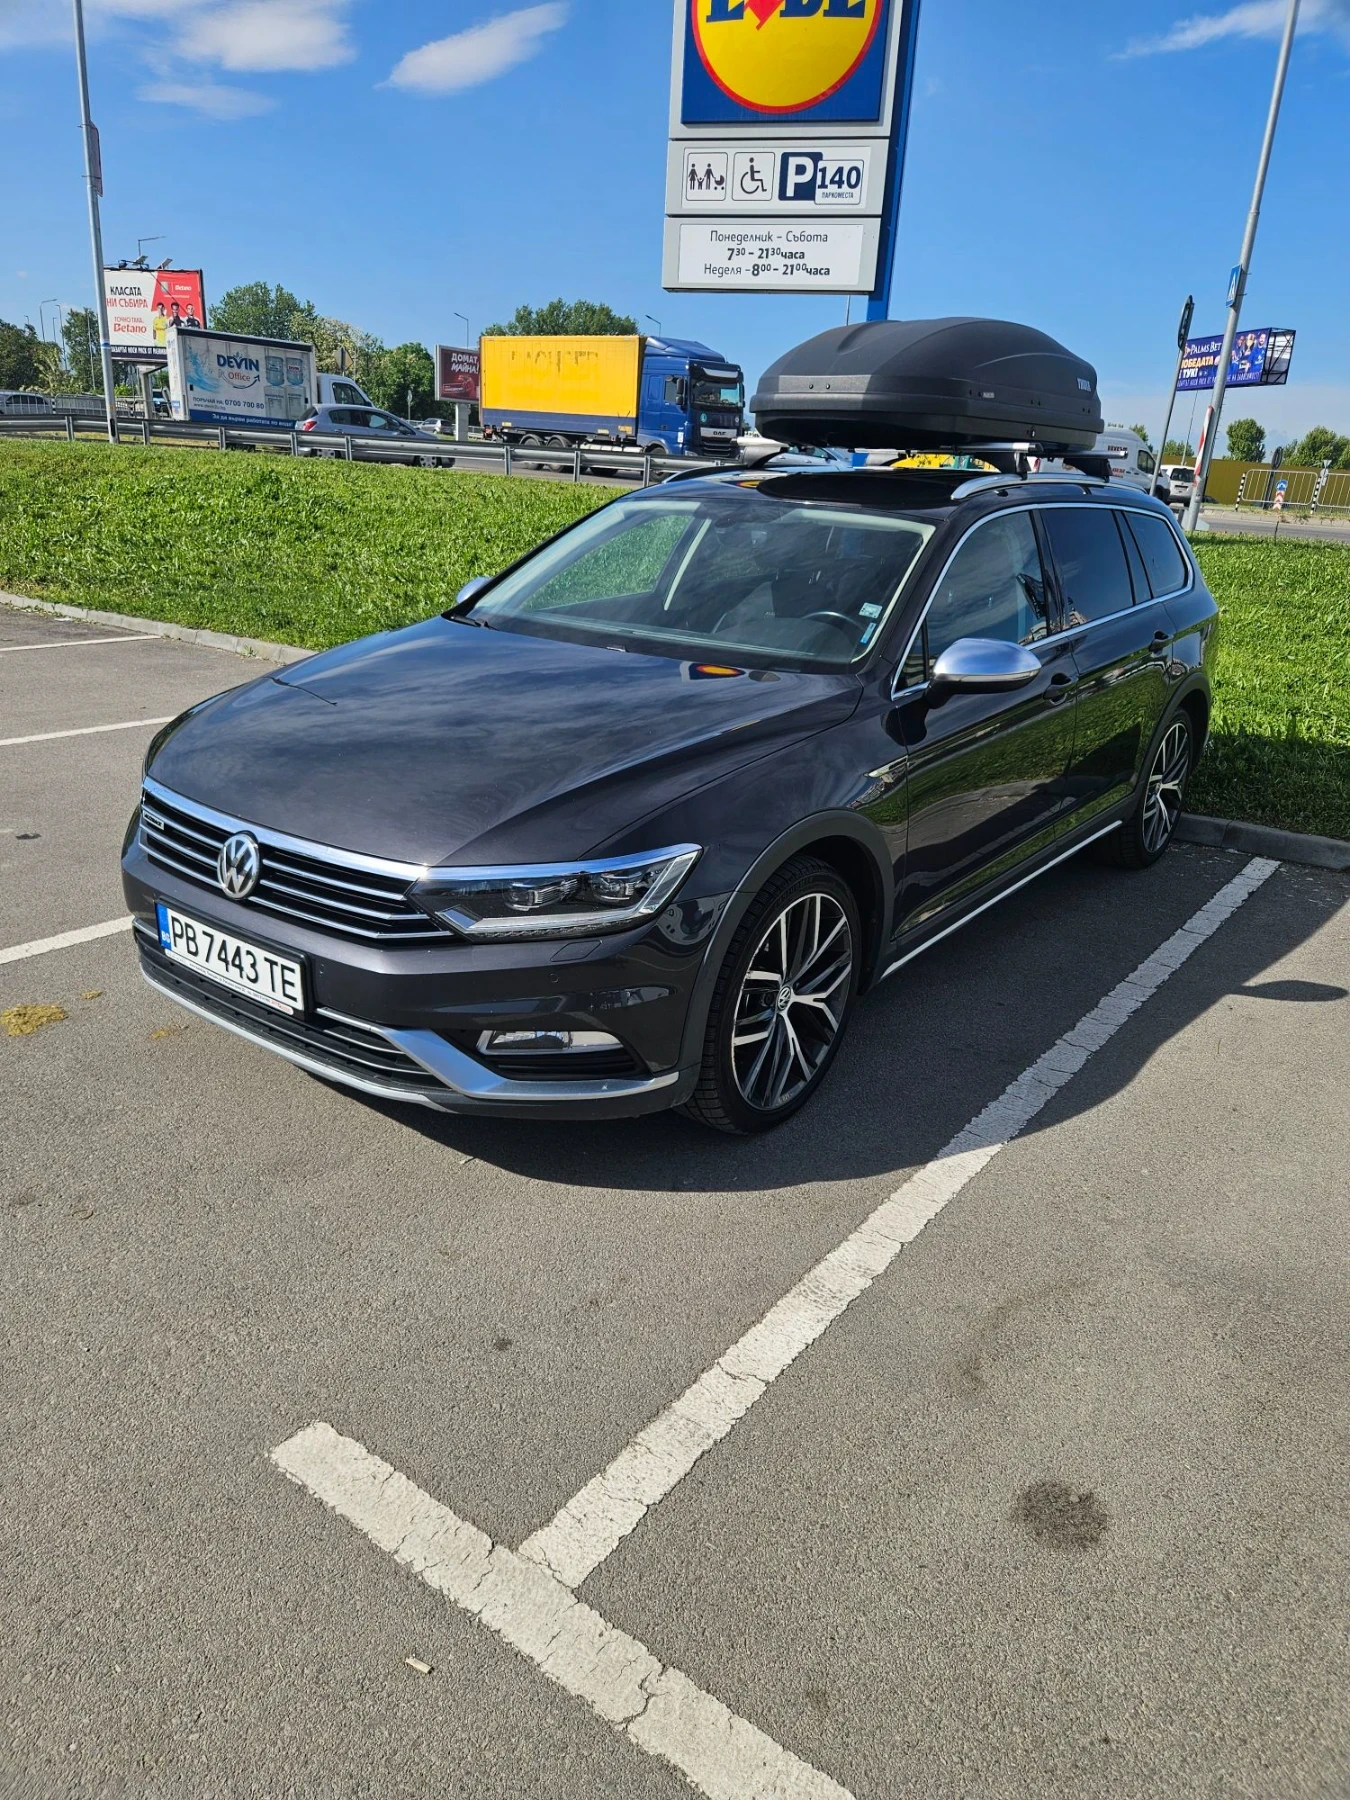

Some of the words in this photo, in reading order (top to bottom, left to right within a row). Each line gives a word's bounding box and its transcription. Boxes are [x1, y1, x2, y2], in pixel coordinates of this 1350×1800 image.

[817, 165, 861, 189] 140
[710, 230, 773, 245] Понеделник
[785, 230, 828, 242] Събота
[704, 263, 742, 278] Неделя
[110, 286, 142, 297] КЛАСАТА
[106, 298, 117, 307] НИ
[118, 298, 148, 308] СЪБИРА
[113, 323, 147, 334] Betano
[216, 353, 259, 372] DEVIN
[228, 371, 251, 382] Office
[224, 399, 242, 407] 0700
[242, 401, 255, 409] 700
